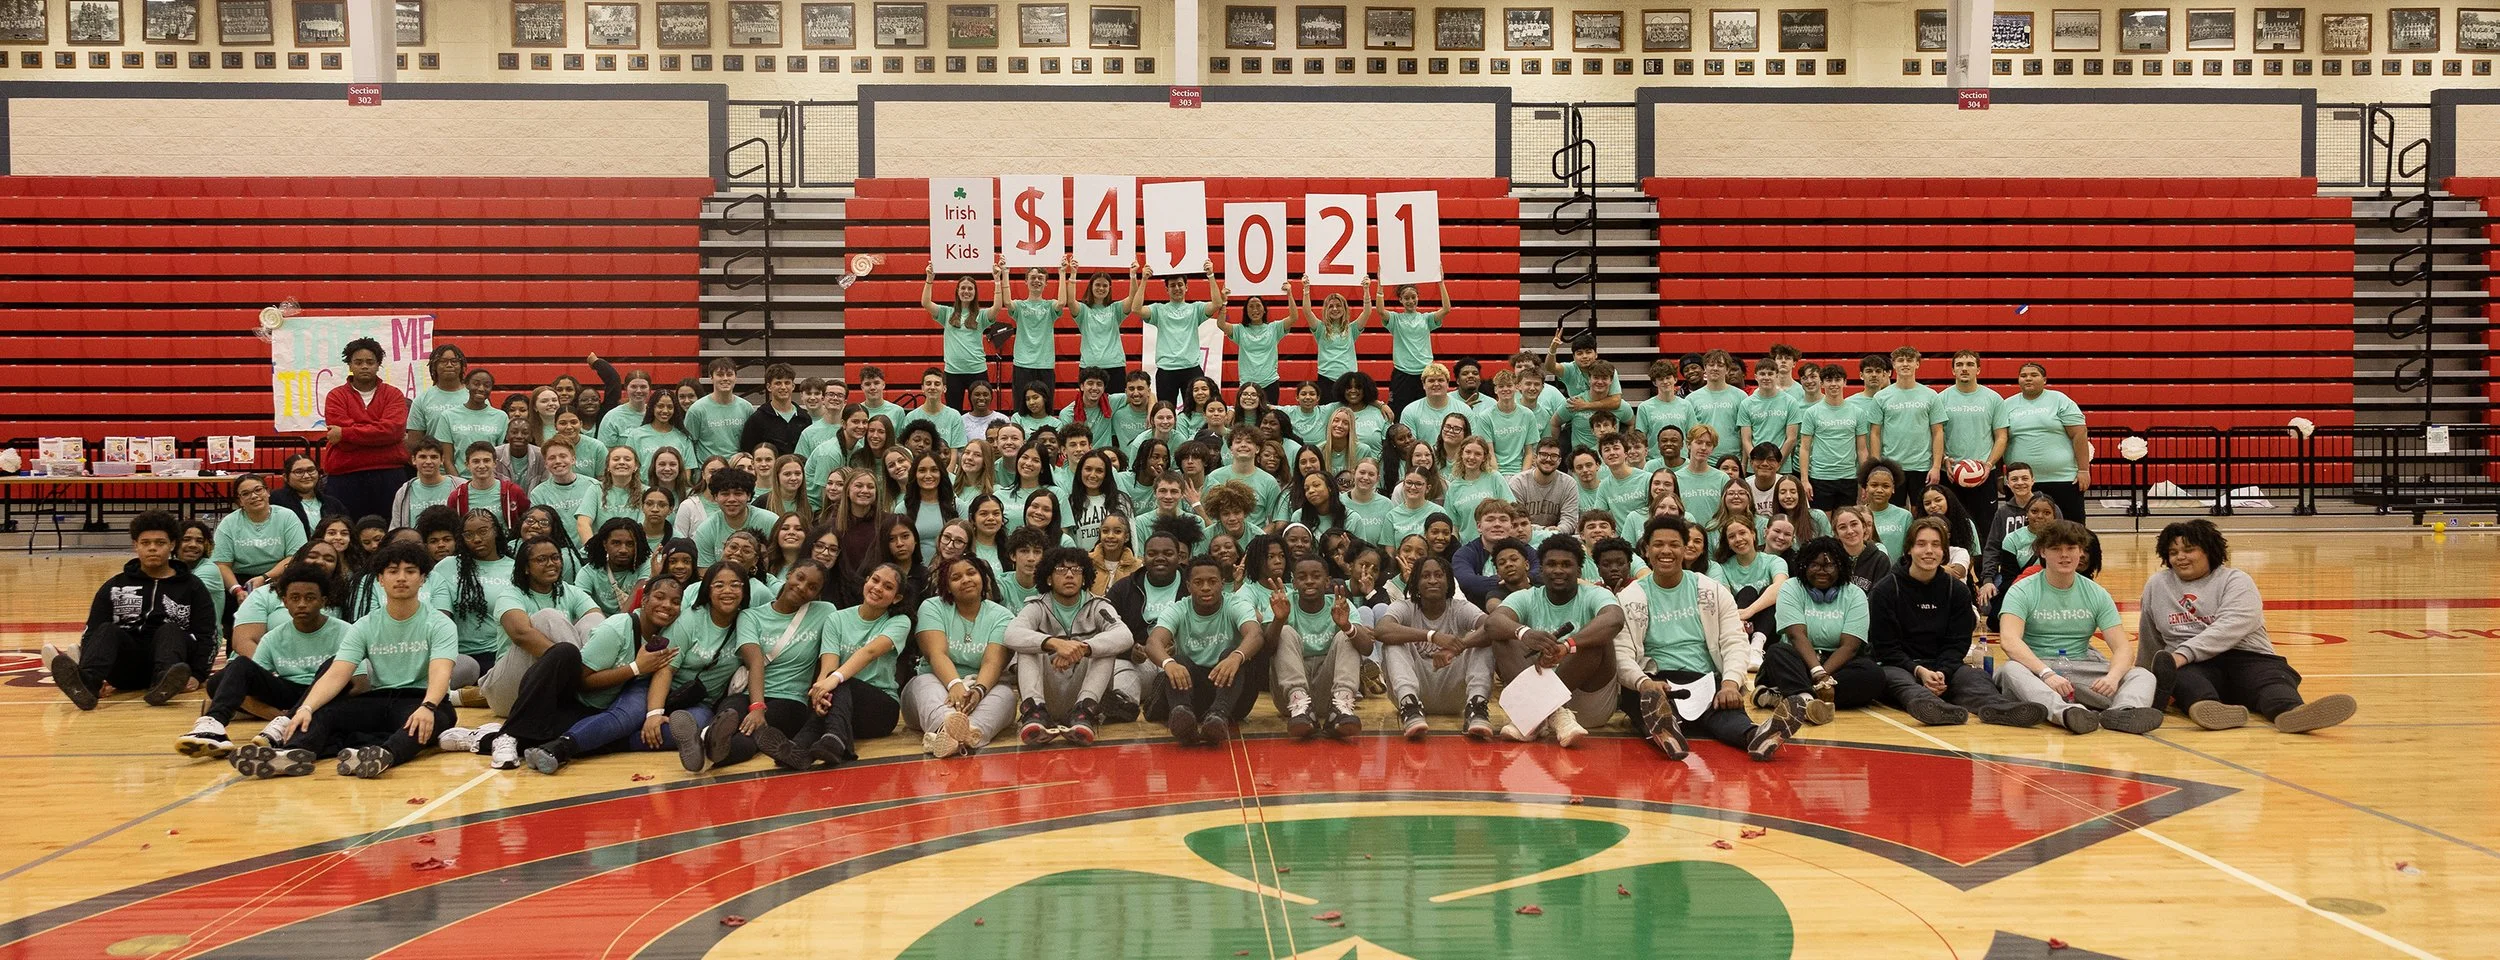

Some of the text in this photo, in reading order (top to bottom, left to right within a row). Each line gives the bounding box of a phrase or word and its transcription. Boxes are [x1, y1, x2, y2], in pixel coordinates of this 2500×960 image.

[350, 87, 379, 95] Section
[1171, 88, 1199, 97] Section
[1960, 91, 1988, 99] Section
[357, 96, 372, 104] 302
[1178, 98, 1193, 106] 303
[945, 204, 977, 221] Irish
[956, 224, 966, 239] 4
[946, 243, 979, 259] Kids
[391, 317, 434, 361] ME
[277, 369, 312, 417] TO
